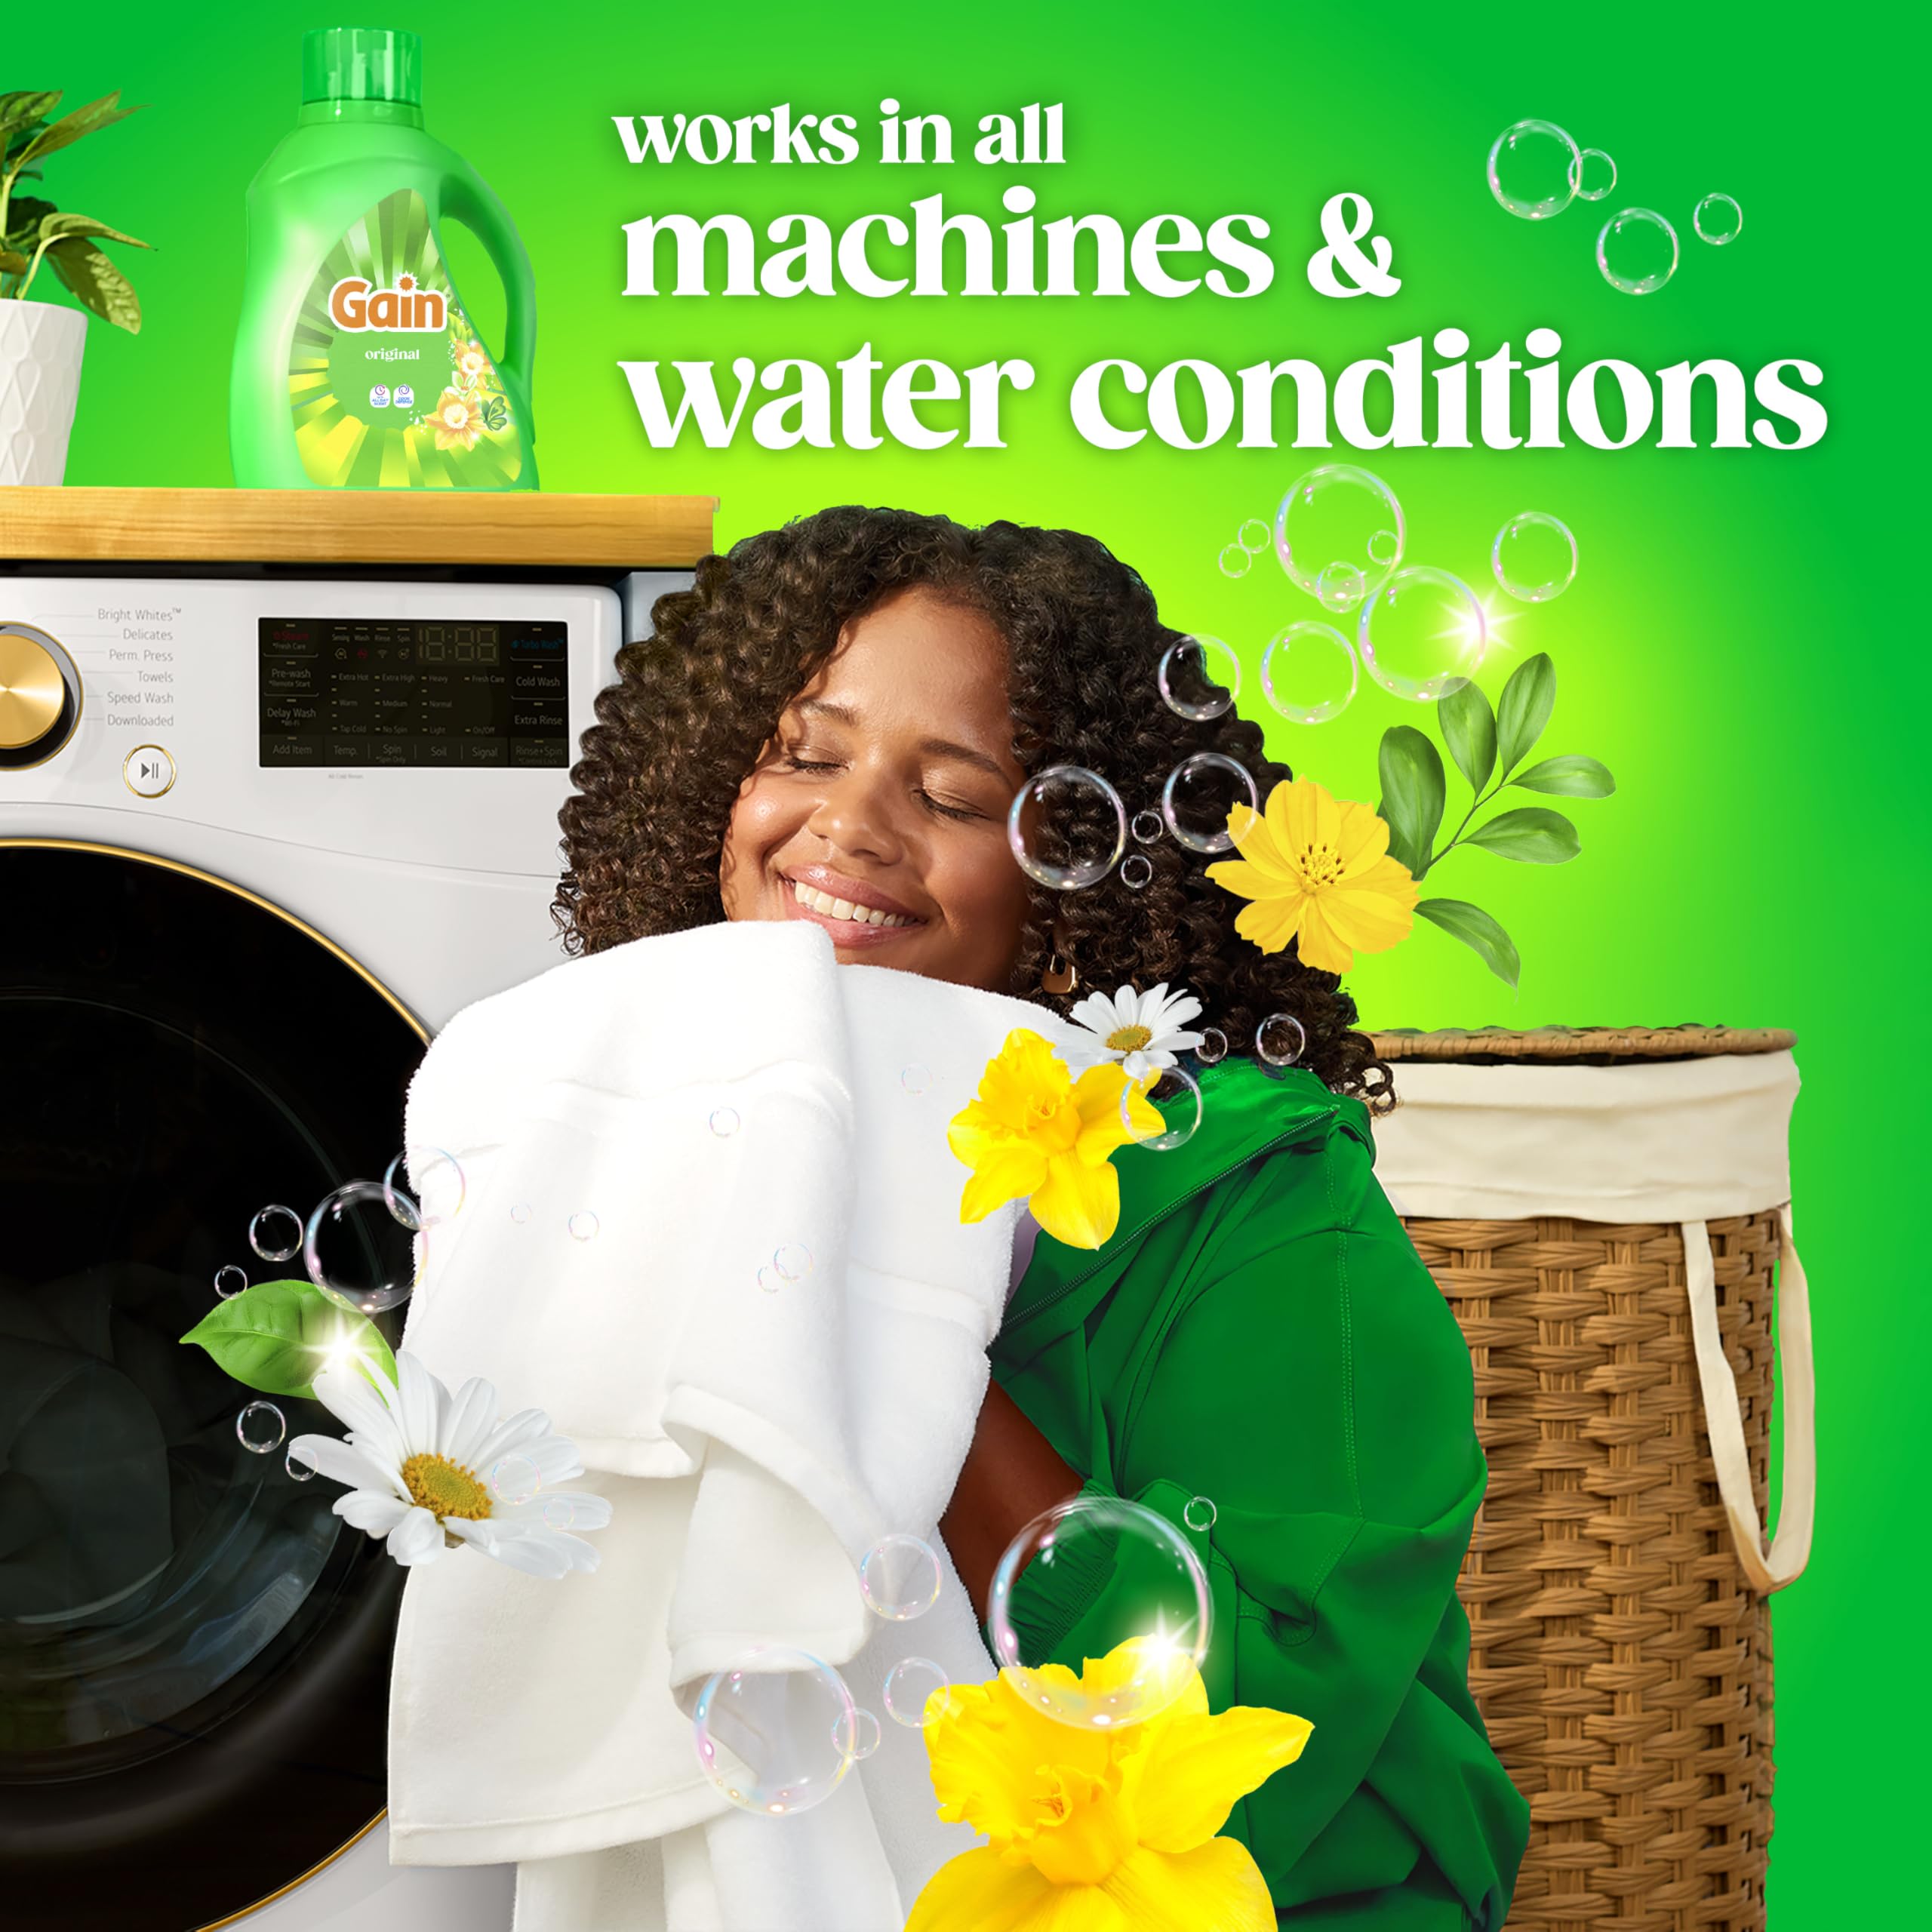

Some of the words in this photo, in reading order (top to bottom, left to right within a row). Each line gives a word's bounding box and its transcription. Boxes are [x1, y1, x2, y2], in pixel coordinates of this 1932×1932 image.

[331, 273, 446, 331] Gain
[365, 348, 420, 362] original
[97, 608, 132, 624] Bright
[123, 629, 174, 641] Delicates
[109, 649, 140, 662] Perm.
[143, 649, 174, 662] Press
[137, 670, 174, 684] Towels
[271, 668, 312, 678] Pre-wash
[429, 675, 448, 684] Heavy
[471, 675, 489, 683] Fresh
[490, 675, 506, 683] Care
[515, 675, 536, 687] Cold
[537, 675, 561, 687] Wash
[107, 691, 141, 706] Speed
[144, 692, 174, 704] Wash
[429, 700, 453, 708] Normal
[266, 707, 291, 720] Delay
[293, 707, 316, 718] Wash
[514, 714, 538, 725] Extra
[539, 714, 564, 726] Rinse
[107, 714, 174, 727] Downloaded
[272, 744, 291, 755] Add
[292, 745, 312, 755] Item
[382, 743, 402, 756] Spin
[430, 745, 448, 757] Soil
[472, 745, 498, 758] Signal
